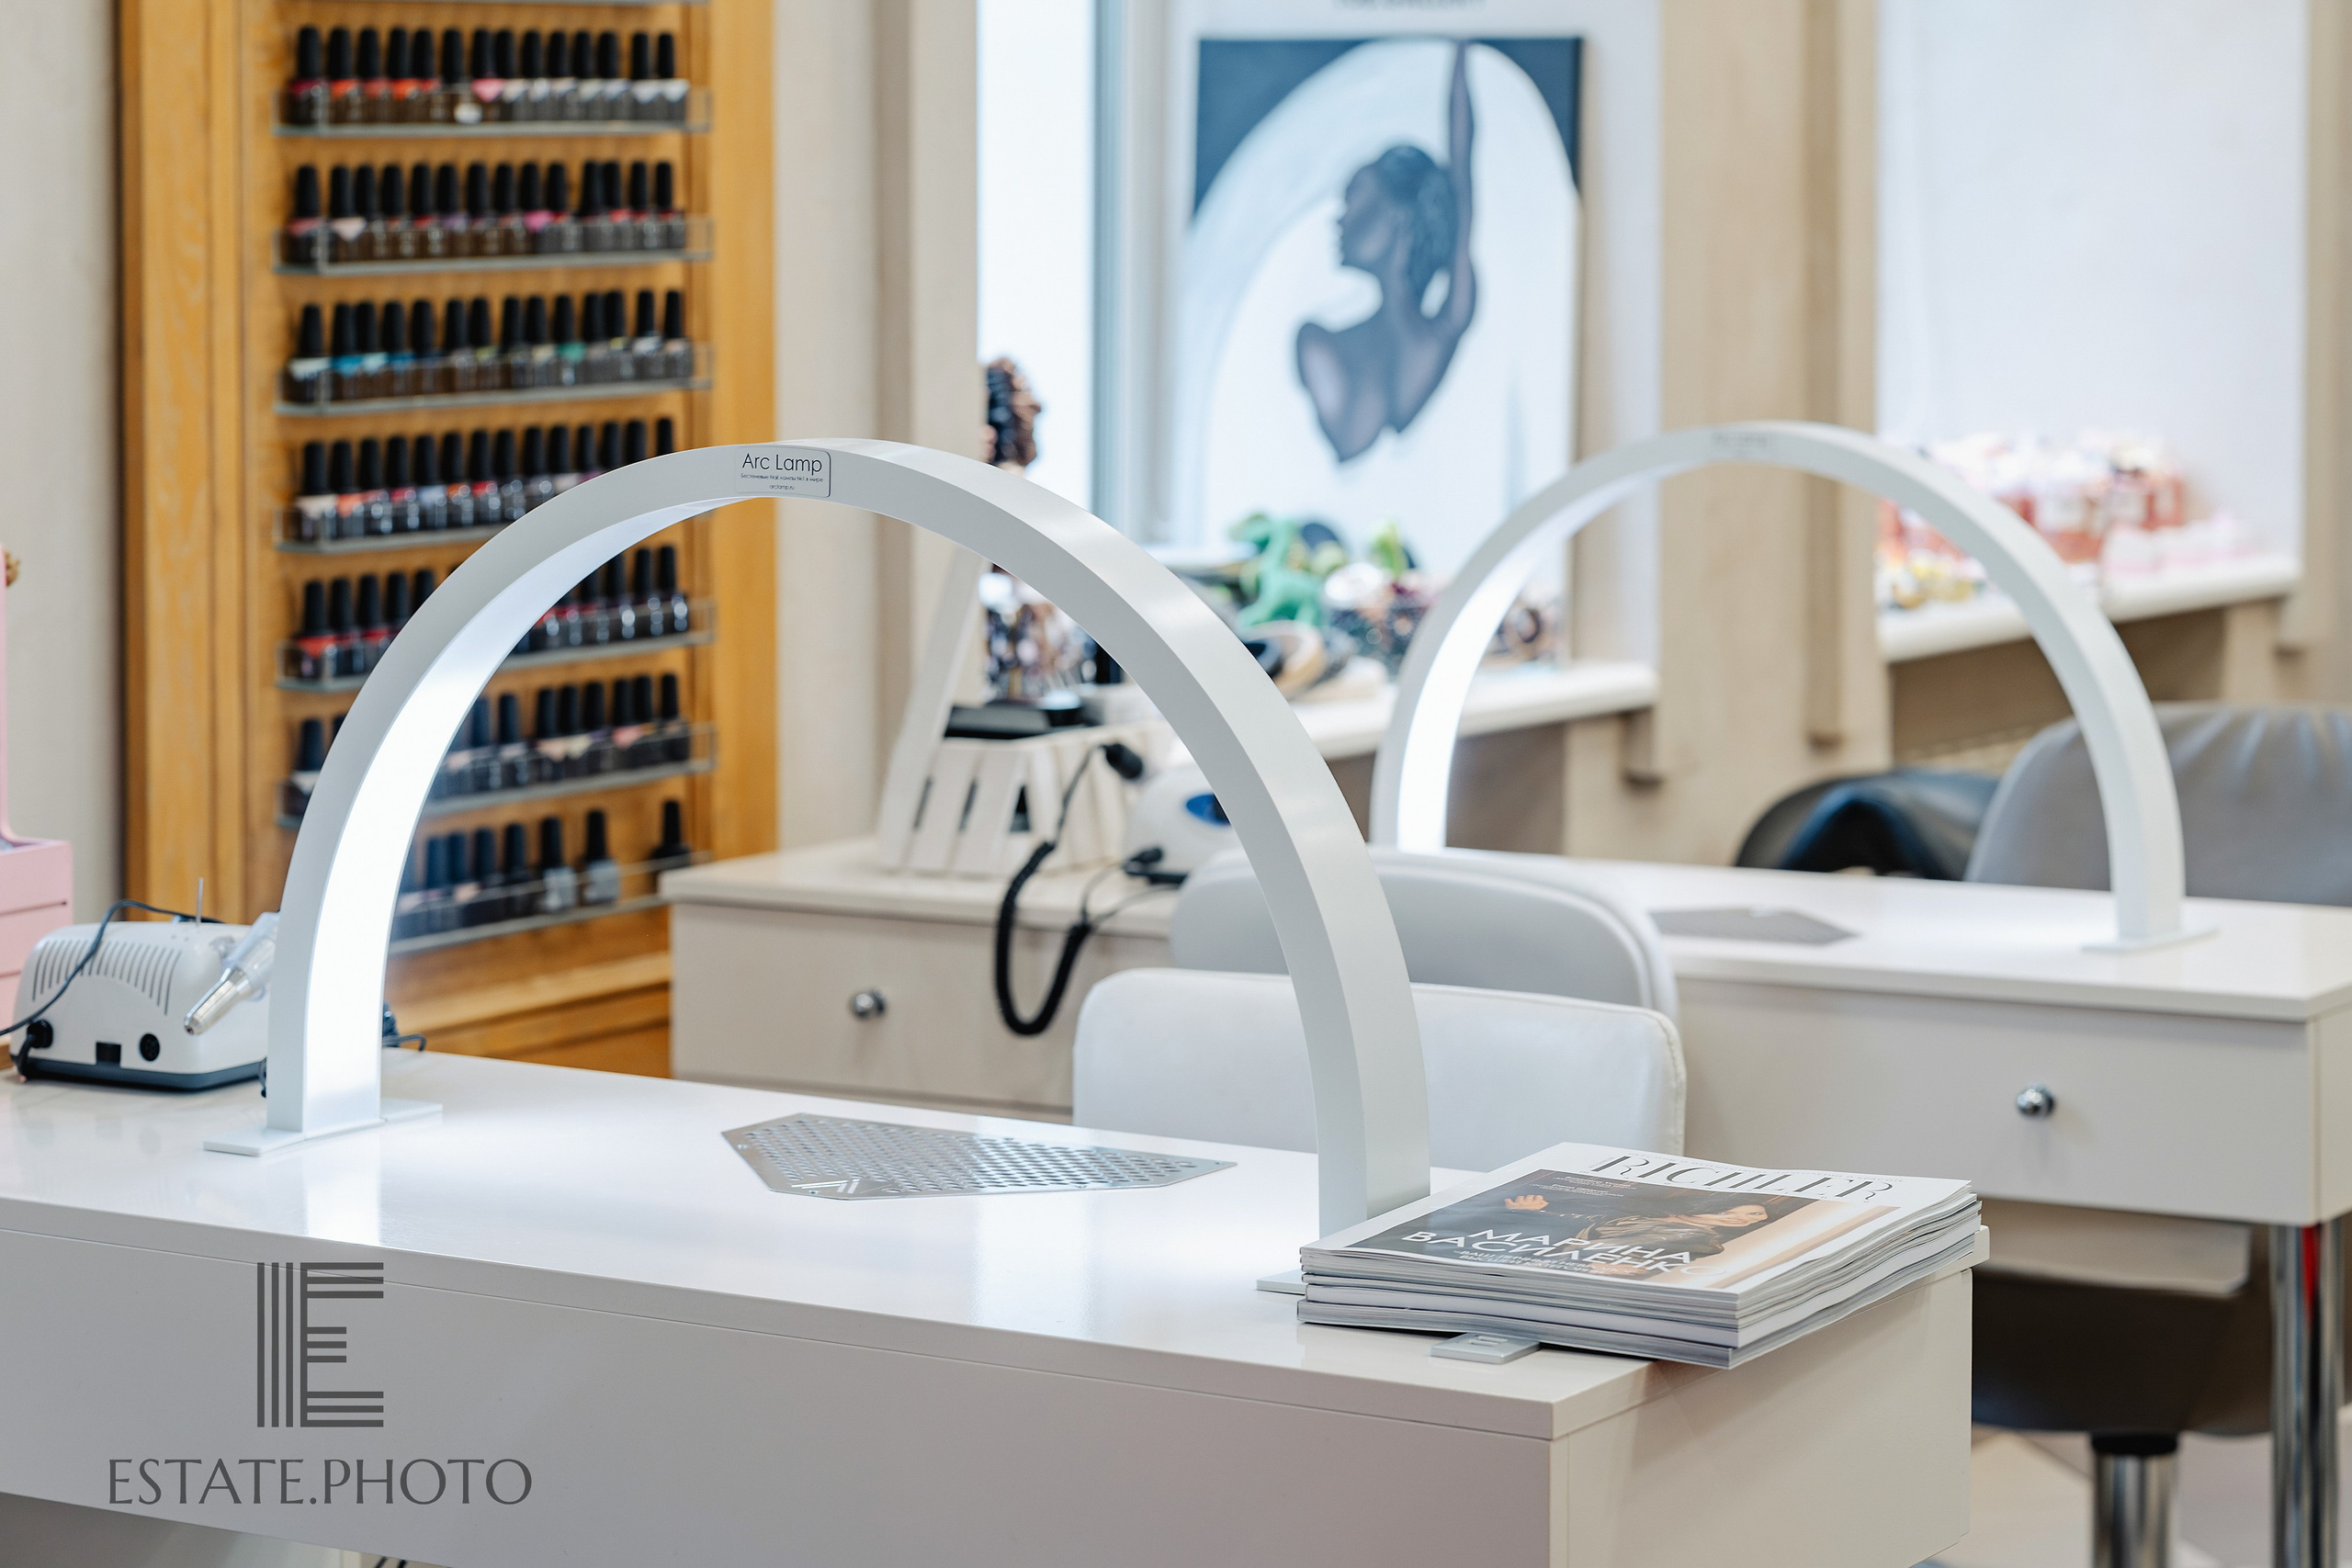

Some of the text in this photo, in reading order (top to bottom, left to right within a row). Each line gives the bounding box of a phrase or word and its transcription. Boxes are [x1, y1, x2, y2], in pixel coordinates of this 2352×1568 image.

[741, 453, 822, 476] Arc Lamp
[1590, 1155, 1894, 1201] RICHLER
[1401, 1231, 1729, 1276] ВАСИЛЕНКО
[1467, 1228, 1690, 1264] МАРИНА
